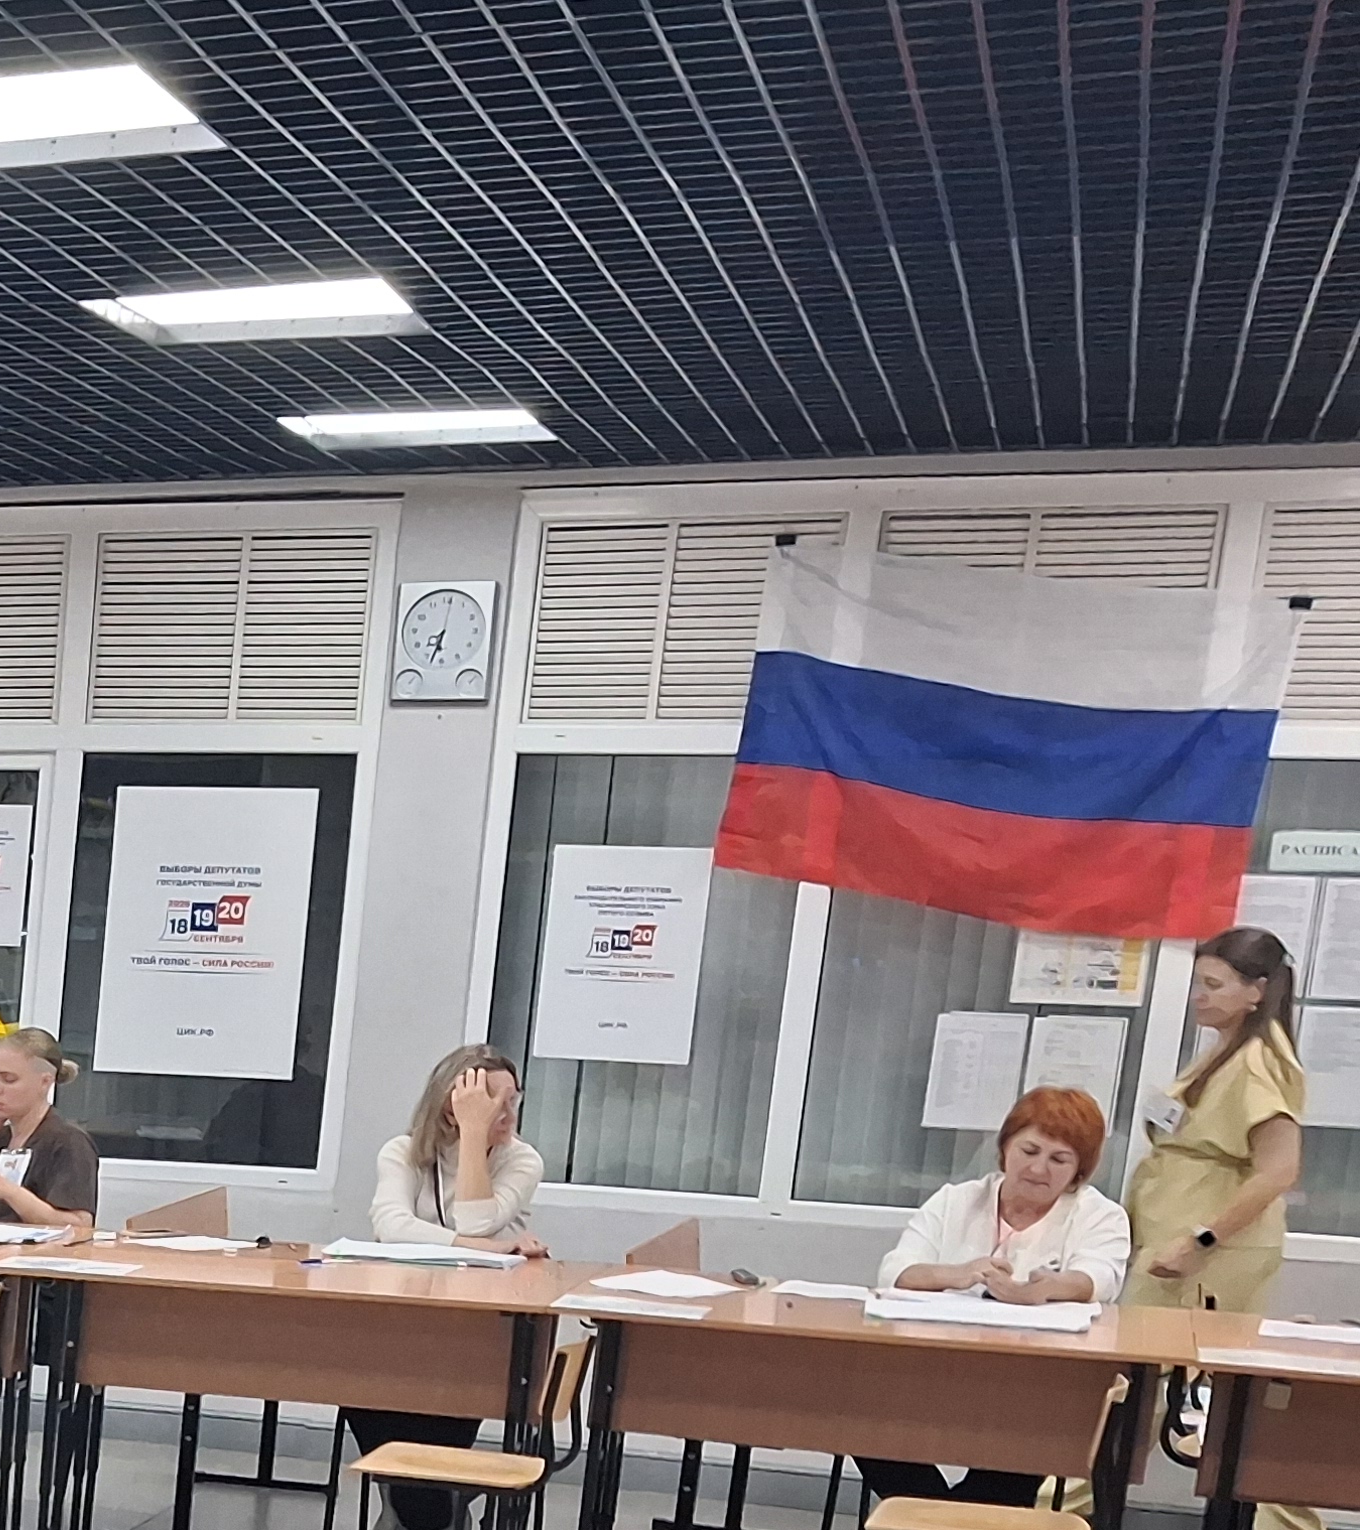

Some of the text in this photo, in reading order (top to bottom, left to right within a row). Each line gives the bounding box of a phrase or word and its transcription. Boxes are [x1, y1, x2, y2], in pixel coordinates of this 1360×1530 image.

[159, 865, 261, 875] ВЫБОРЫ ДЕПУТАТОВ
[218, 902, 244, 919] 20
[193, 909, 214, 927] 19
[169, 918, 188, 934] 18
[193, 934, 244, 943] СЕНТЯБРЯ
[633, 929, 653, 942] 20
[131, 955, 156, 965] ТВОЙ
[158, 957, 191, 967] ГОЛОС
[202, 959, 228, 967] СИЛА
[176, 1027, 214, 1037] ЦИК.РФ
